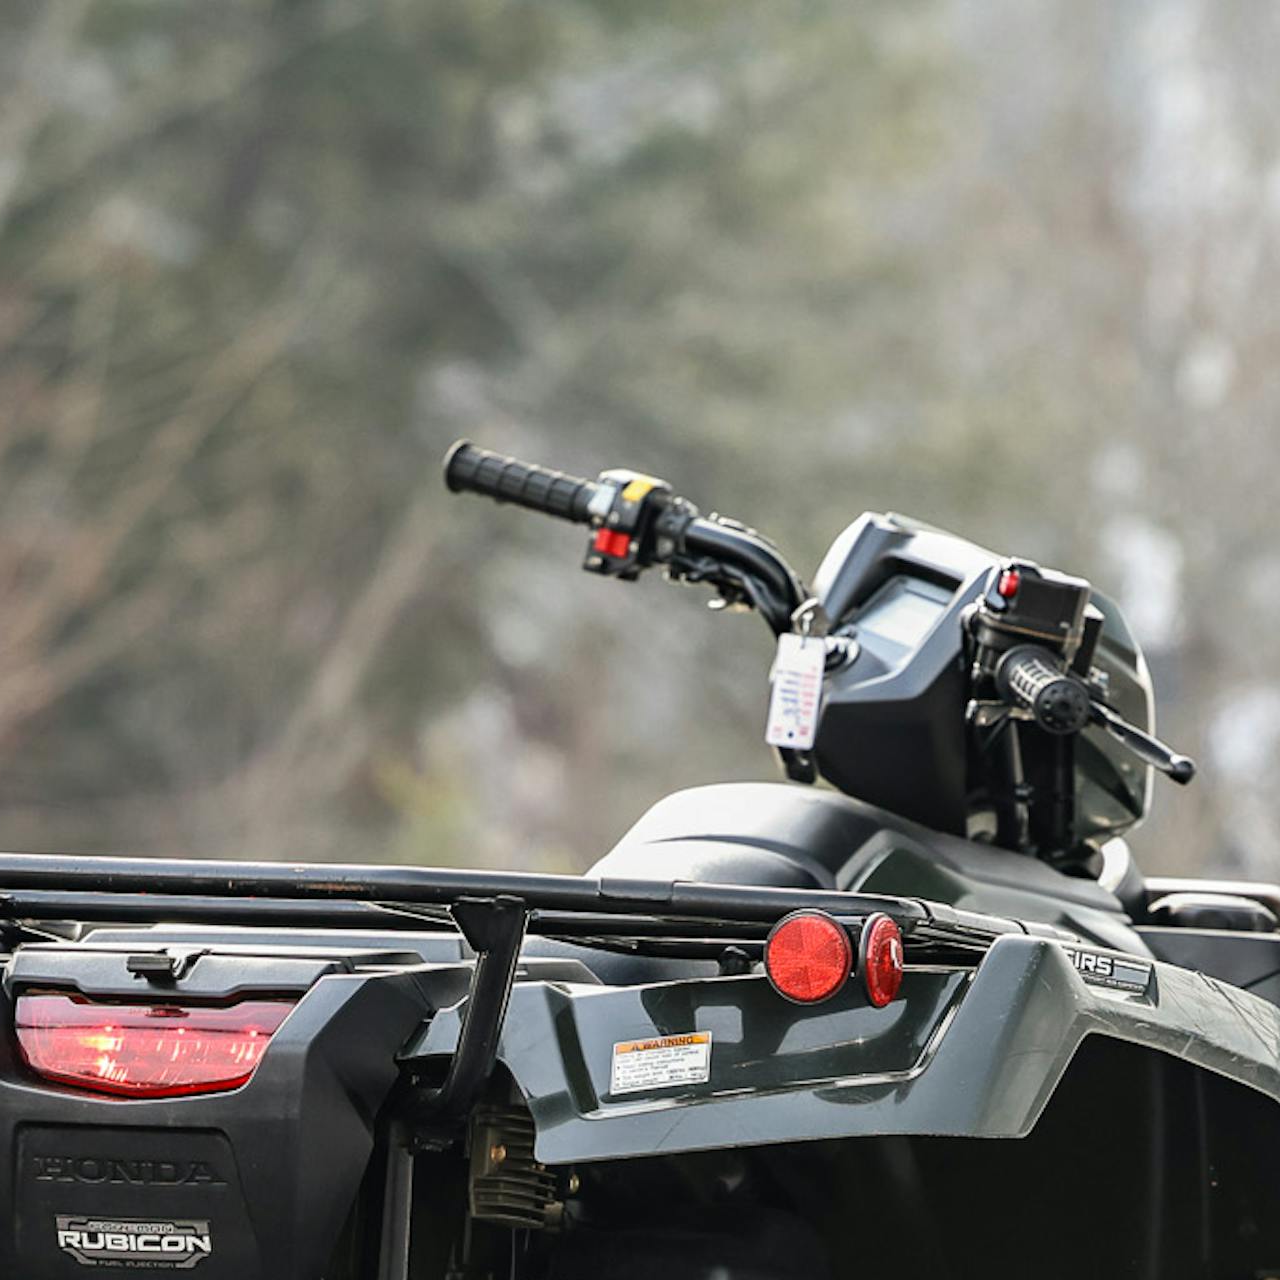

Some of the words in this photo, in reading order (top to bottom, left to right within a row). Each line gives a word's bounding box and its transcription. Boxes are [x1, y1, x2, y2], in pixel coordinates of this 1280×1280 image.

[643, 1035, 694, 1050] WARNING
[32, 1156, 229, 1187] HONDA
[56, 1229, 212, 1253] RUBICON
